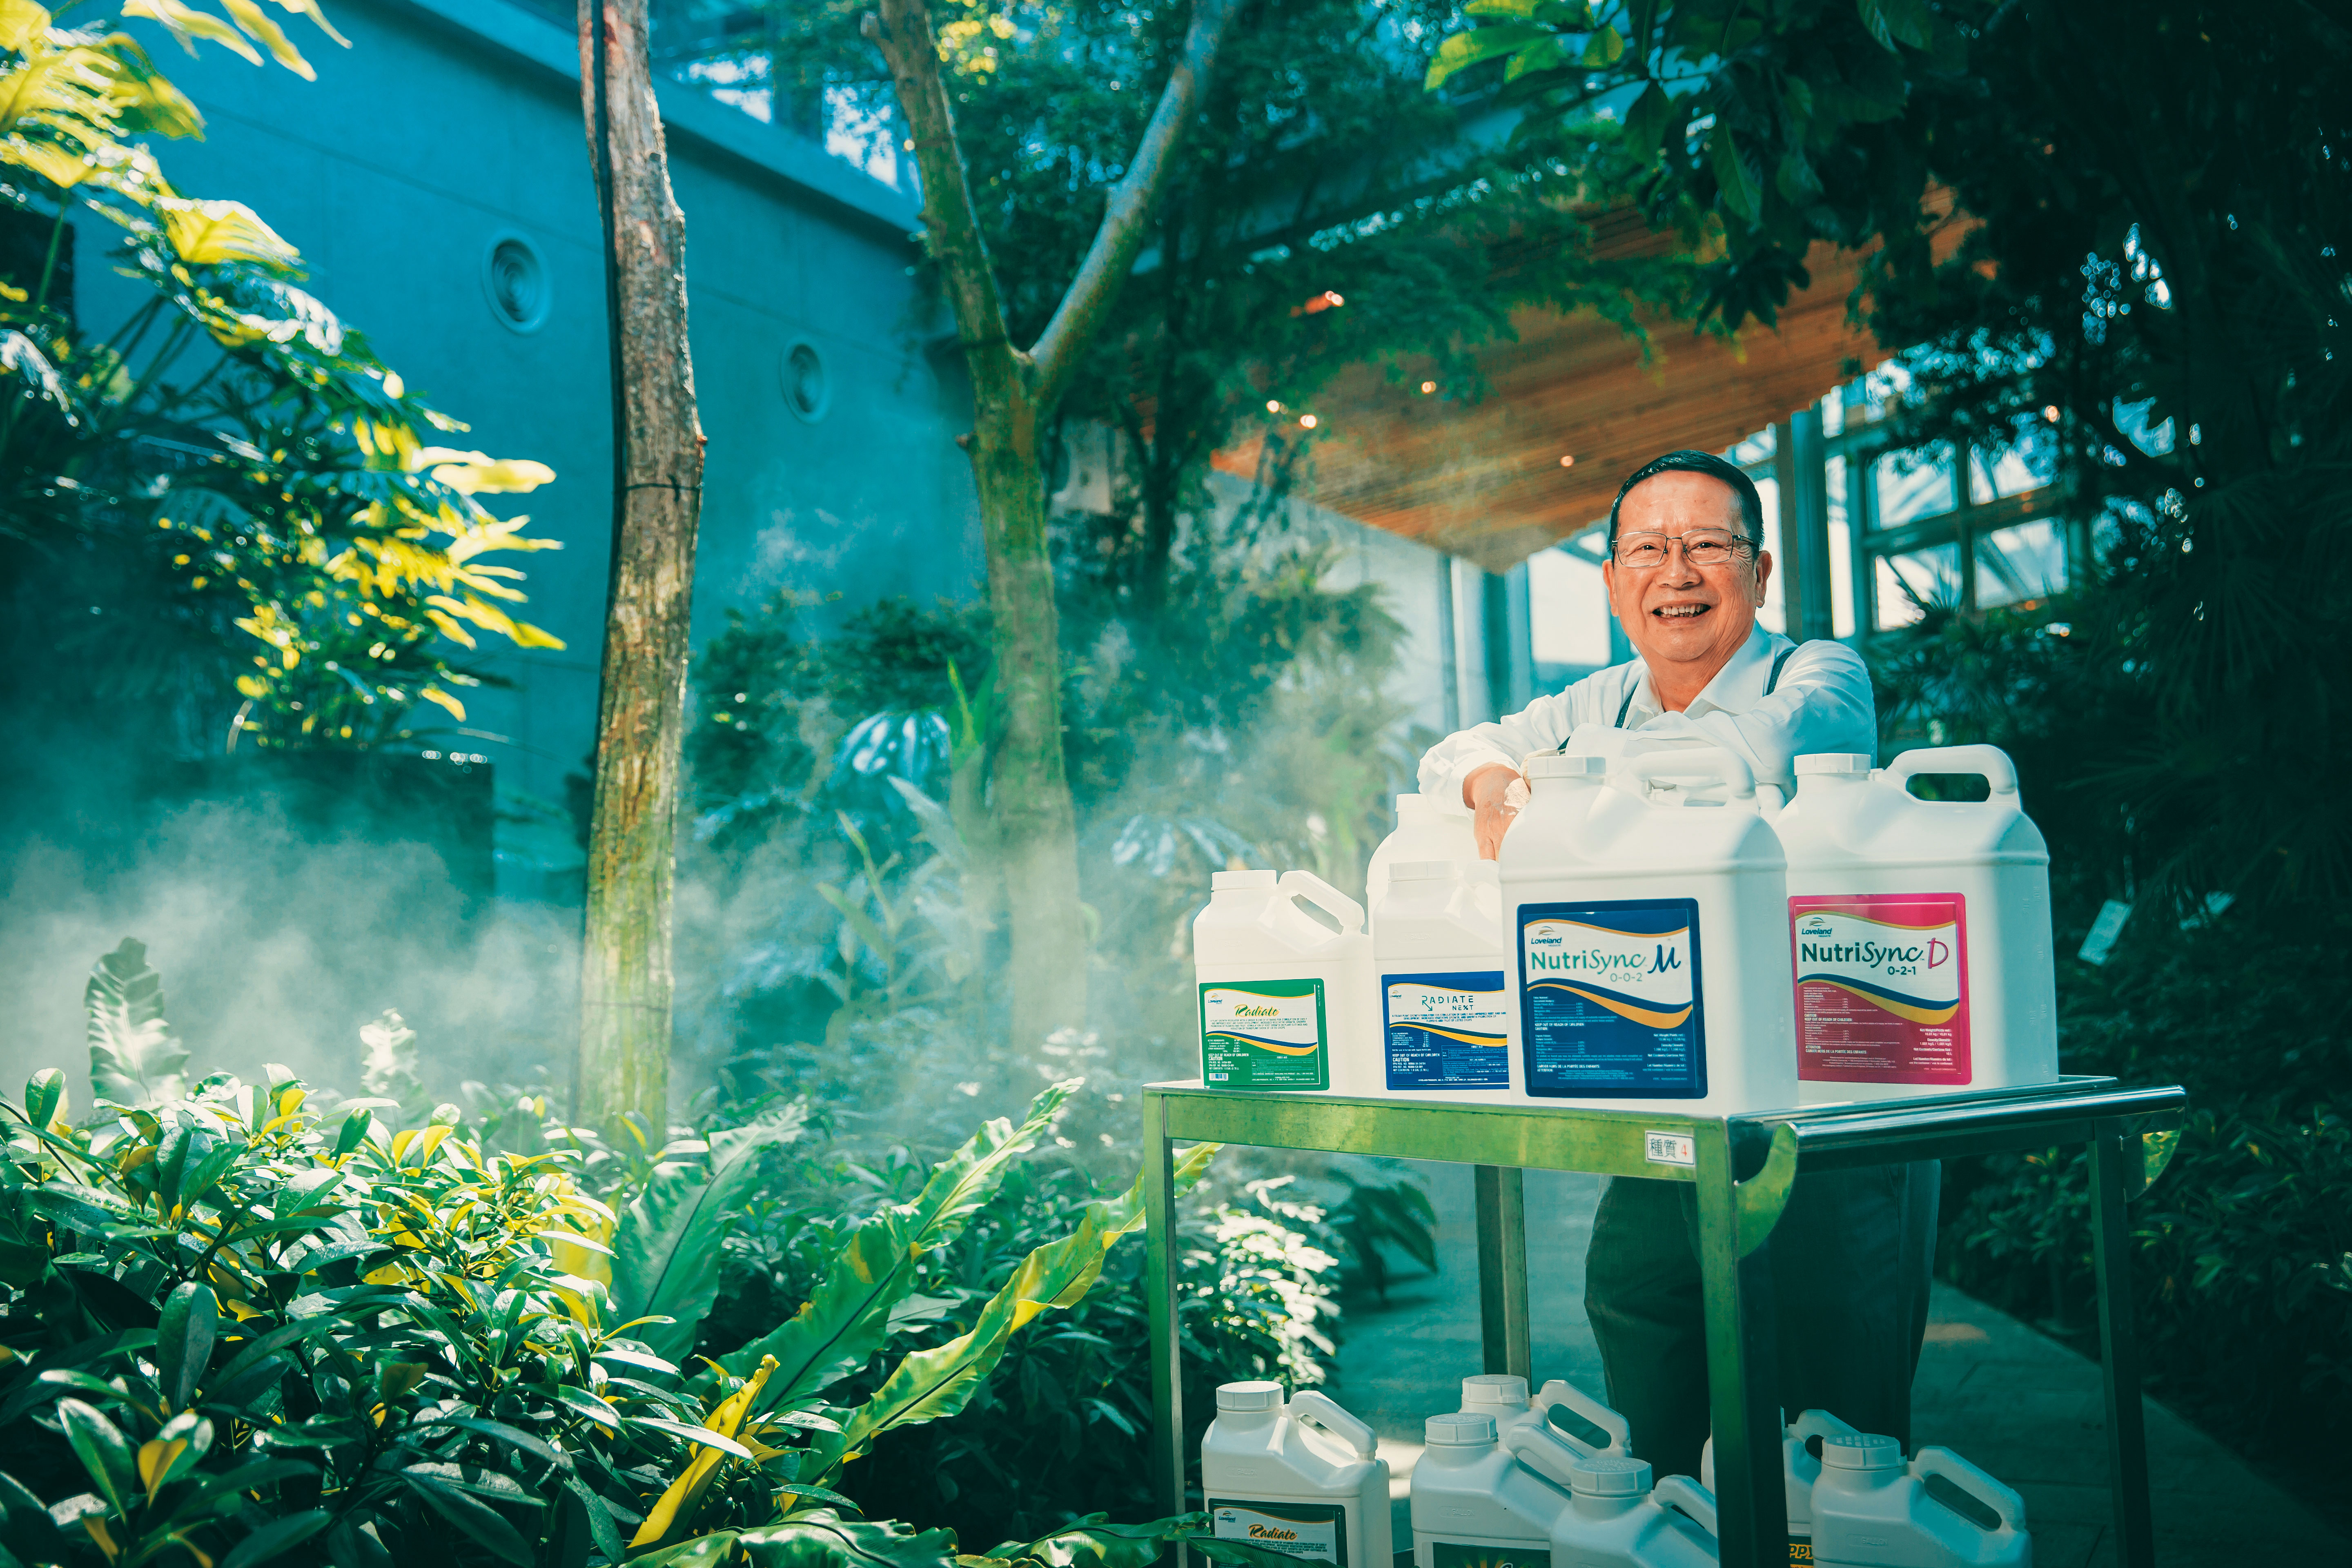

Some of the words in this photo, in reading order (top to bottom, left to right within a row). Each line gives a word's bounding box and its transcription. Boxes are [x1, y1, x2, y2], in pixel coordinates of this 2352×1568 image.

[1802, 941, 1923, 968] NutriSync
[1927, 937, 1949, 969] D
[1531, 949, 1646, 974] NutriSync
[1610, 972, 1642, 982] 0-0-2
[1887, 966, 1916, 975] 0-2-1
[1422, 996, 1473, 1007] RADIATE
[1234, 1004, 1278, 1017] Radiate
[1649, 1138, 1676, 1159] 種質
[1681, 1144, 1687, 1157] 4
[1249, 1524, 1296, 1540] Radiate
